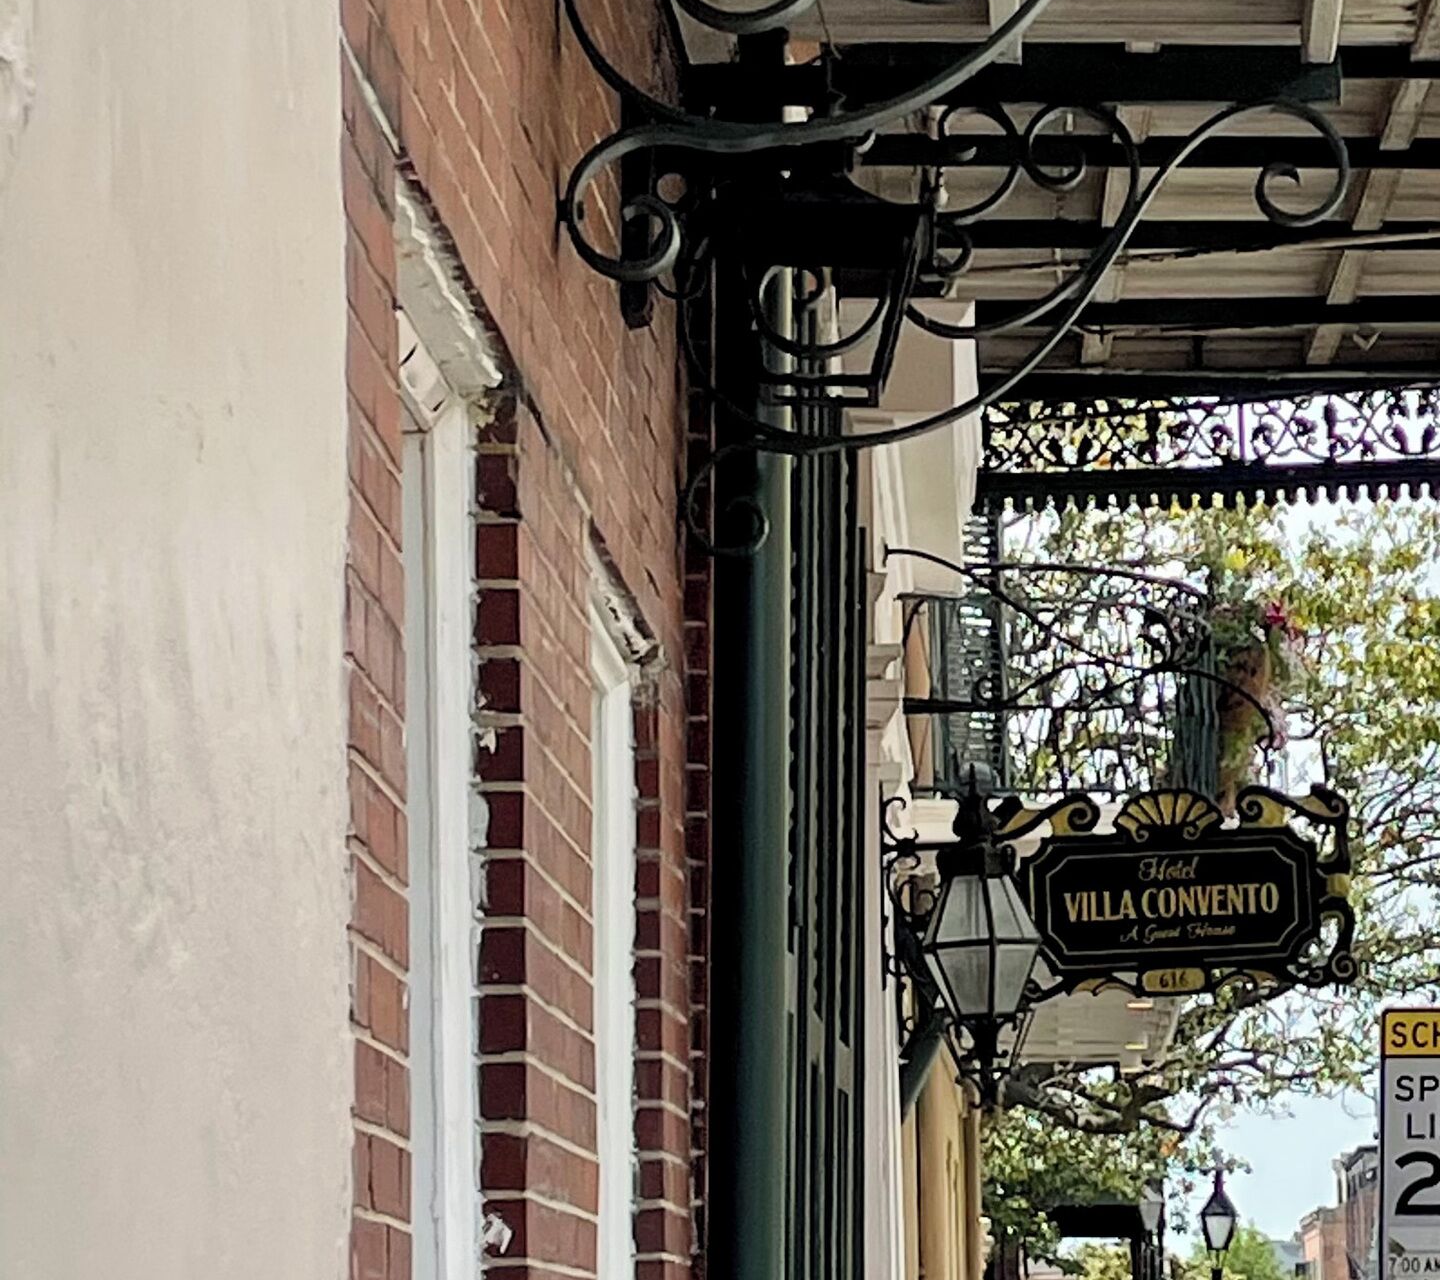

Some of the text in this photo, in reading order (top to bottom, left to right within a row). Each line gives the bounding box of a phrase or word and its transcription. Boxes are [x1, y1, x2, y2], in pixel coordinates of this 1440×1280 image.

[1139, 856, 1199, 881] Hotel
[1064, 882, 1280, 922] VILLA CONVENTO
[1120, 926, 1138, 942] A
[1188, 921, 1237, 939] House
[1159, 970, 1190, 988] 616
